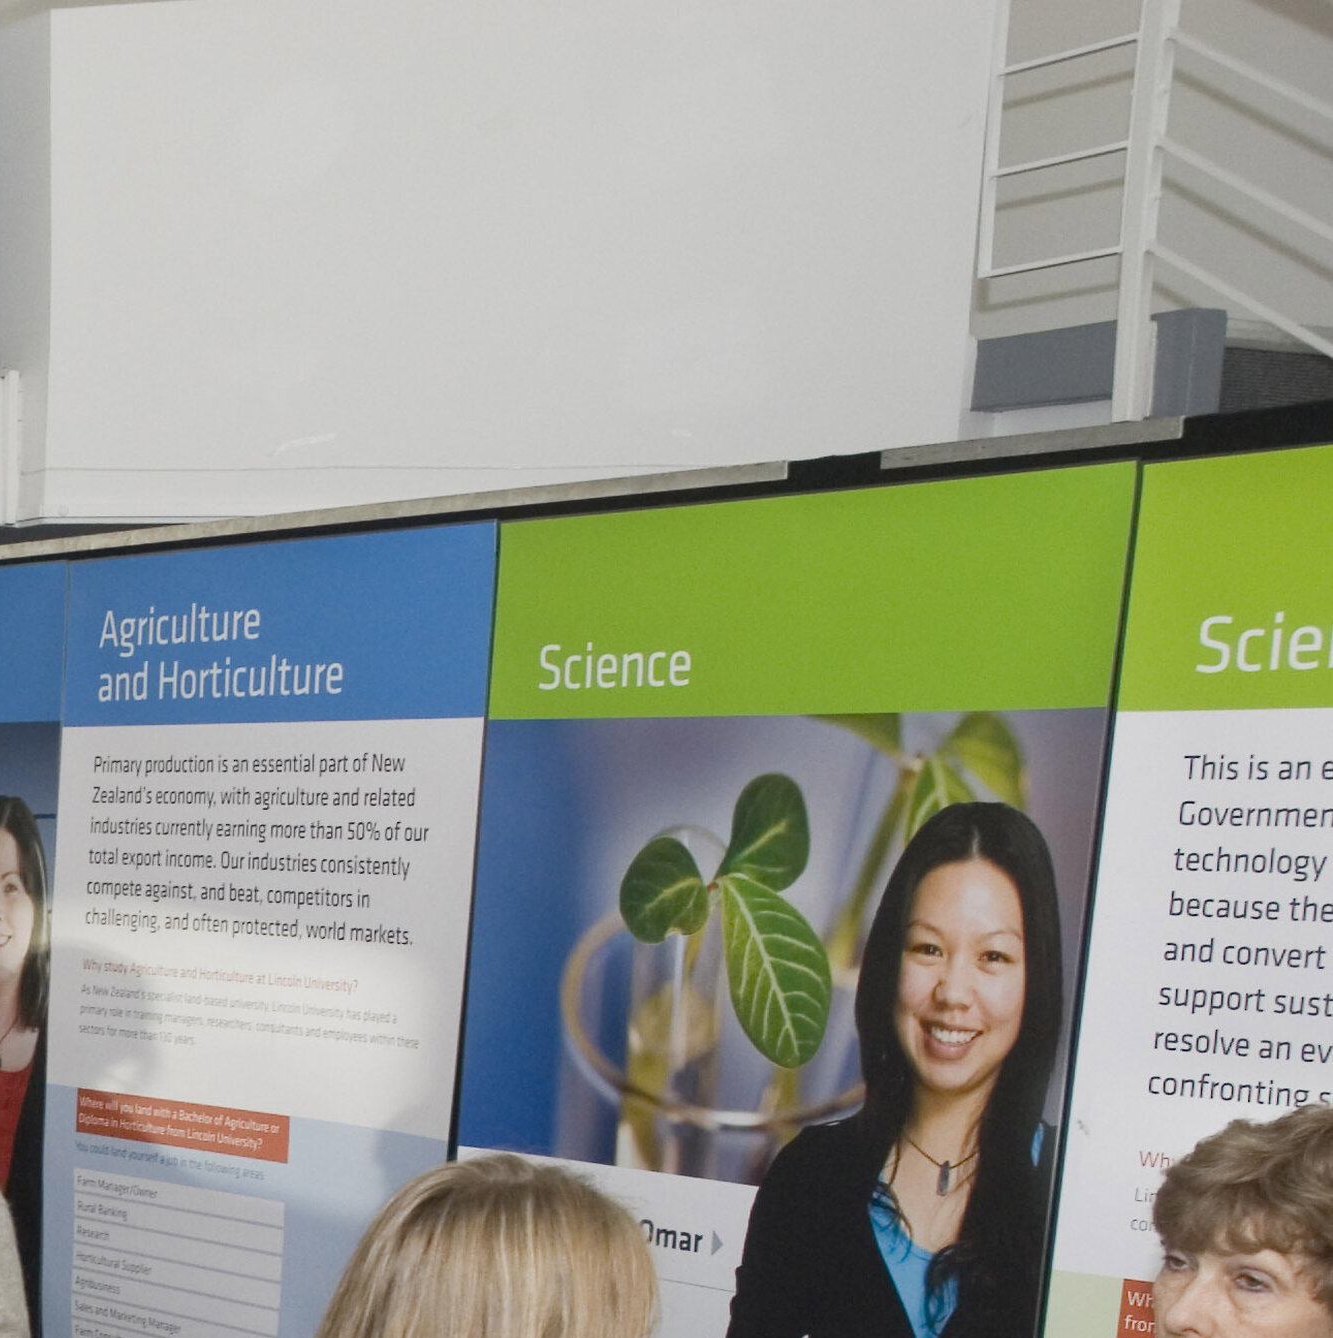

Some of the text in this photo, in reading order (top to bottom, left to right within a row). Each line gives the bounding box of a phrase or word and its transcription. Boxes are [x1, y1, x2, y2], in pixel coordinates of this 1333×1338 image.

[99, 602, 262, 658] Agriculture
[1195, 611, 1333, 674] Scie
[98, 653, 344, 703] and Horticulture
[538, 642, 691, 690] Science
[93, 751, 406, 778] Primary production is an essential part of New
[1184, 755, 1311, 781] This is an
[91, 785, 416, 812] Zealand's economy, with agriculture and related
[90, 815, 430, 844] industries currently earning more than 50% of our
[88, 847, 411, 882] total export income. Our industries consistently
[1174, 846, 1327, 882] technology
[86, 879, 371, 911] compete against, and beat, competitors in
[1168, 892, 1280, 921] because
[85, 907, 413, 947] challenging, and often protected, world markets.
[1163, 938, 1327, 970] and convert
[1158, 984, 1266, 1016] support
[1153, 1029, 1250, 1058] resolve
[1259, 1038, 1291, 1060] an
[1148, 1073, 1309, 1108] confronting
[79, 1112, 263, 1152] Diploma in Horticulture from Lincoln University?
[80, 1096, 280, 1134] Where will you land with a Bachelor of Agriculture or
